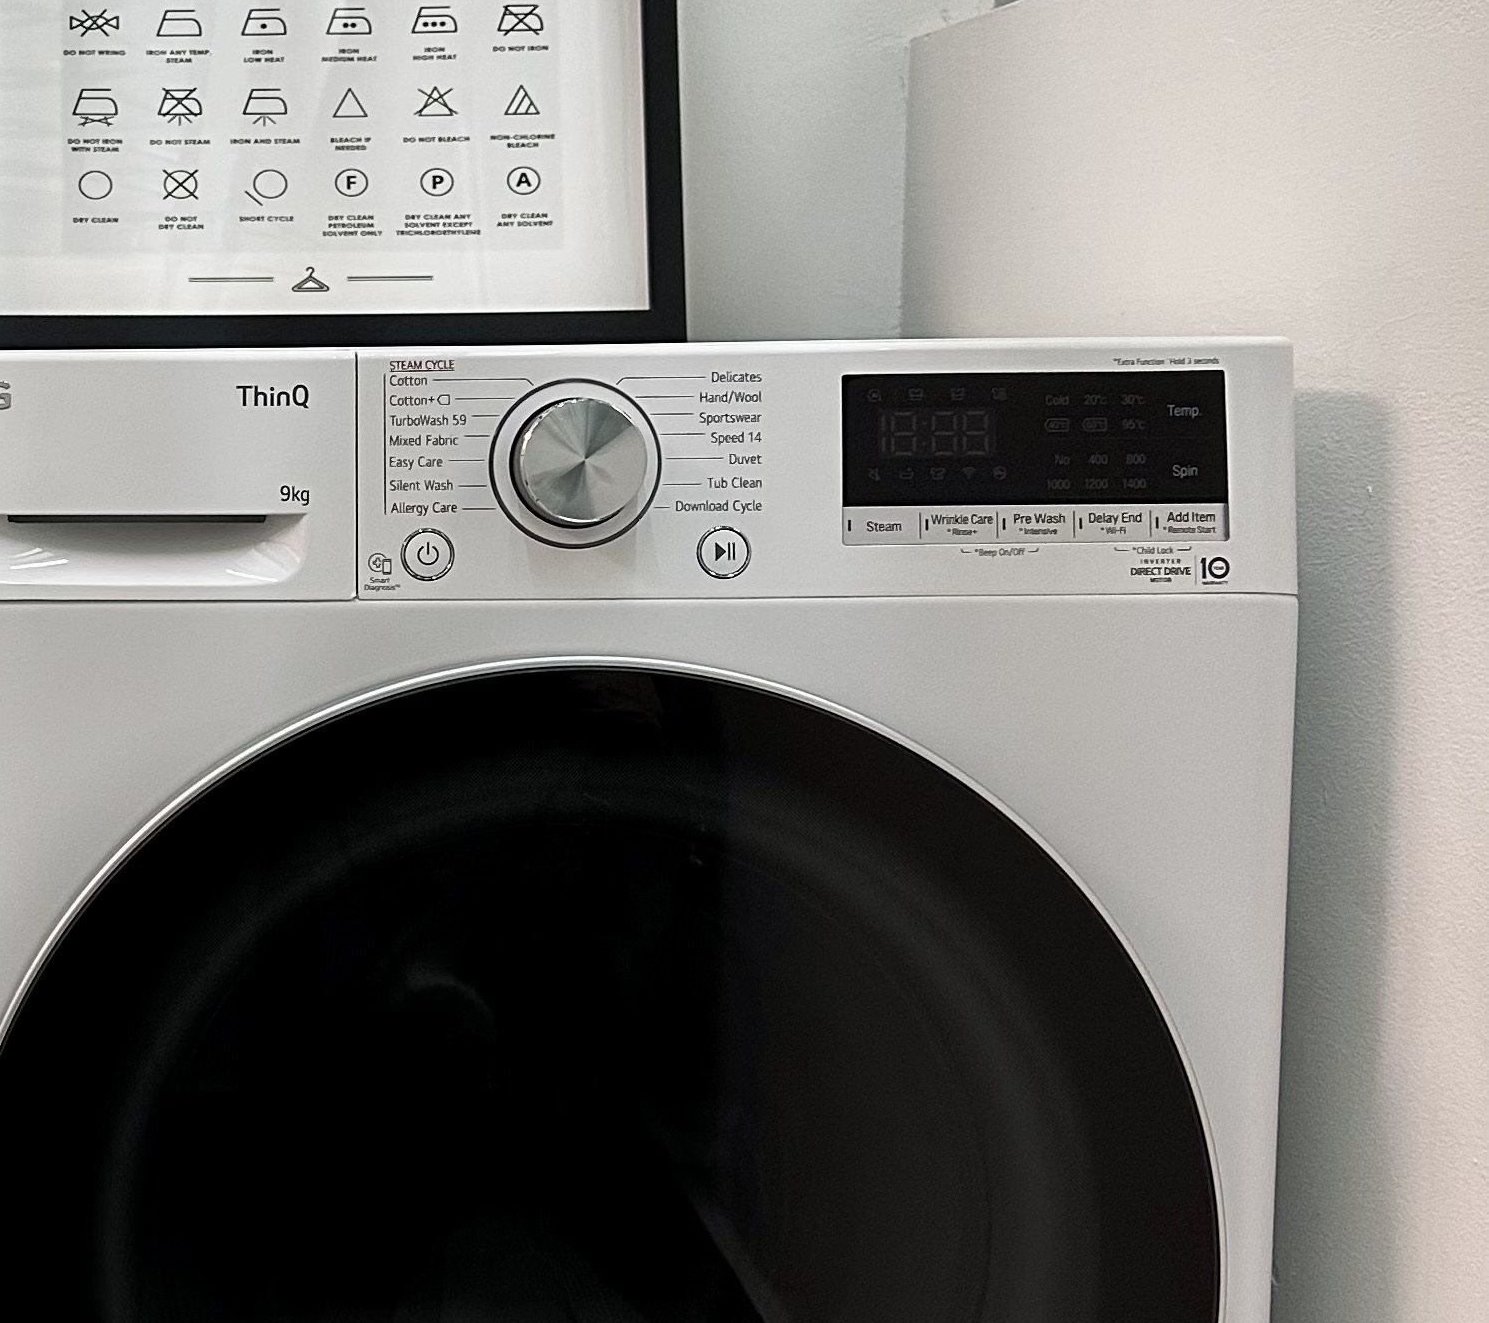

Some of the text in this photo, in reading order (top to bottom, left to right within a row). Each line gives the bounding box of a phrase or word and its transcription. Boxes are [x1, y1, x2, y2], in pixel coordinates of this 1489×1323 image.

[346, 176, 356, 189] F
[432, 175, 443, 189] P
[516, 173, 531, 187] A
[389, 360, 455, 370] STEAM CYCLE
[389, 375, 428, 386] Cotton
[711, 371, 762, 383] Delicates
[236, 384, 309, 409] ThinQ
[389, 395, 435, 406] Cotton+
[699, 390, 762, 404] Hand/Wool
[1167, 404, 1202, 419] Temp.
[390, 414, 467, 427] TurboWash 59
[699, 412, 762, 426] Sportswear
[389, 435, 459, 446] Mixed Fabric
[711, 431, 762, 446] Speed 14
[390, 456, 443, 470] Easy Care
[729, 454, 762, 465] Duvet
[1172, 464, 1198, 479] Spin
[389, 479, 453, 491] Silent Wash
[707, 477, 763, 489] Tub Clean
[280, 485, 310, 506] 9kg
[390, 502, 458, 516] Allergy Care
[675, 500, 763, 514] Download Cycle
[931, 514, 994, 525] Wrinkle Care
[1013, 513, 1066, 524] Pre Wash
[1088, 512, 1142, 526] Delay End
[1167, 512, 1216, 523] Add Item
[866, 520, 902, 532] Steam
[1130, 567, 1192, 576] DIRECT DRIVE
